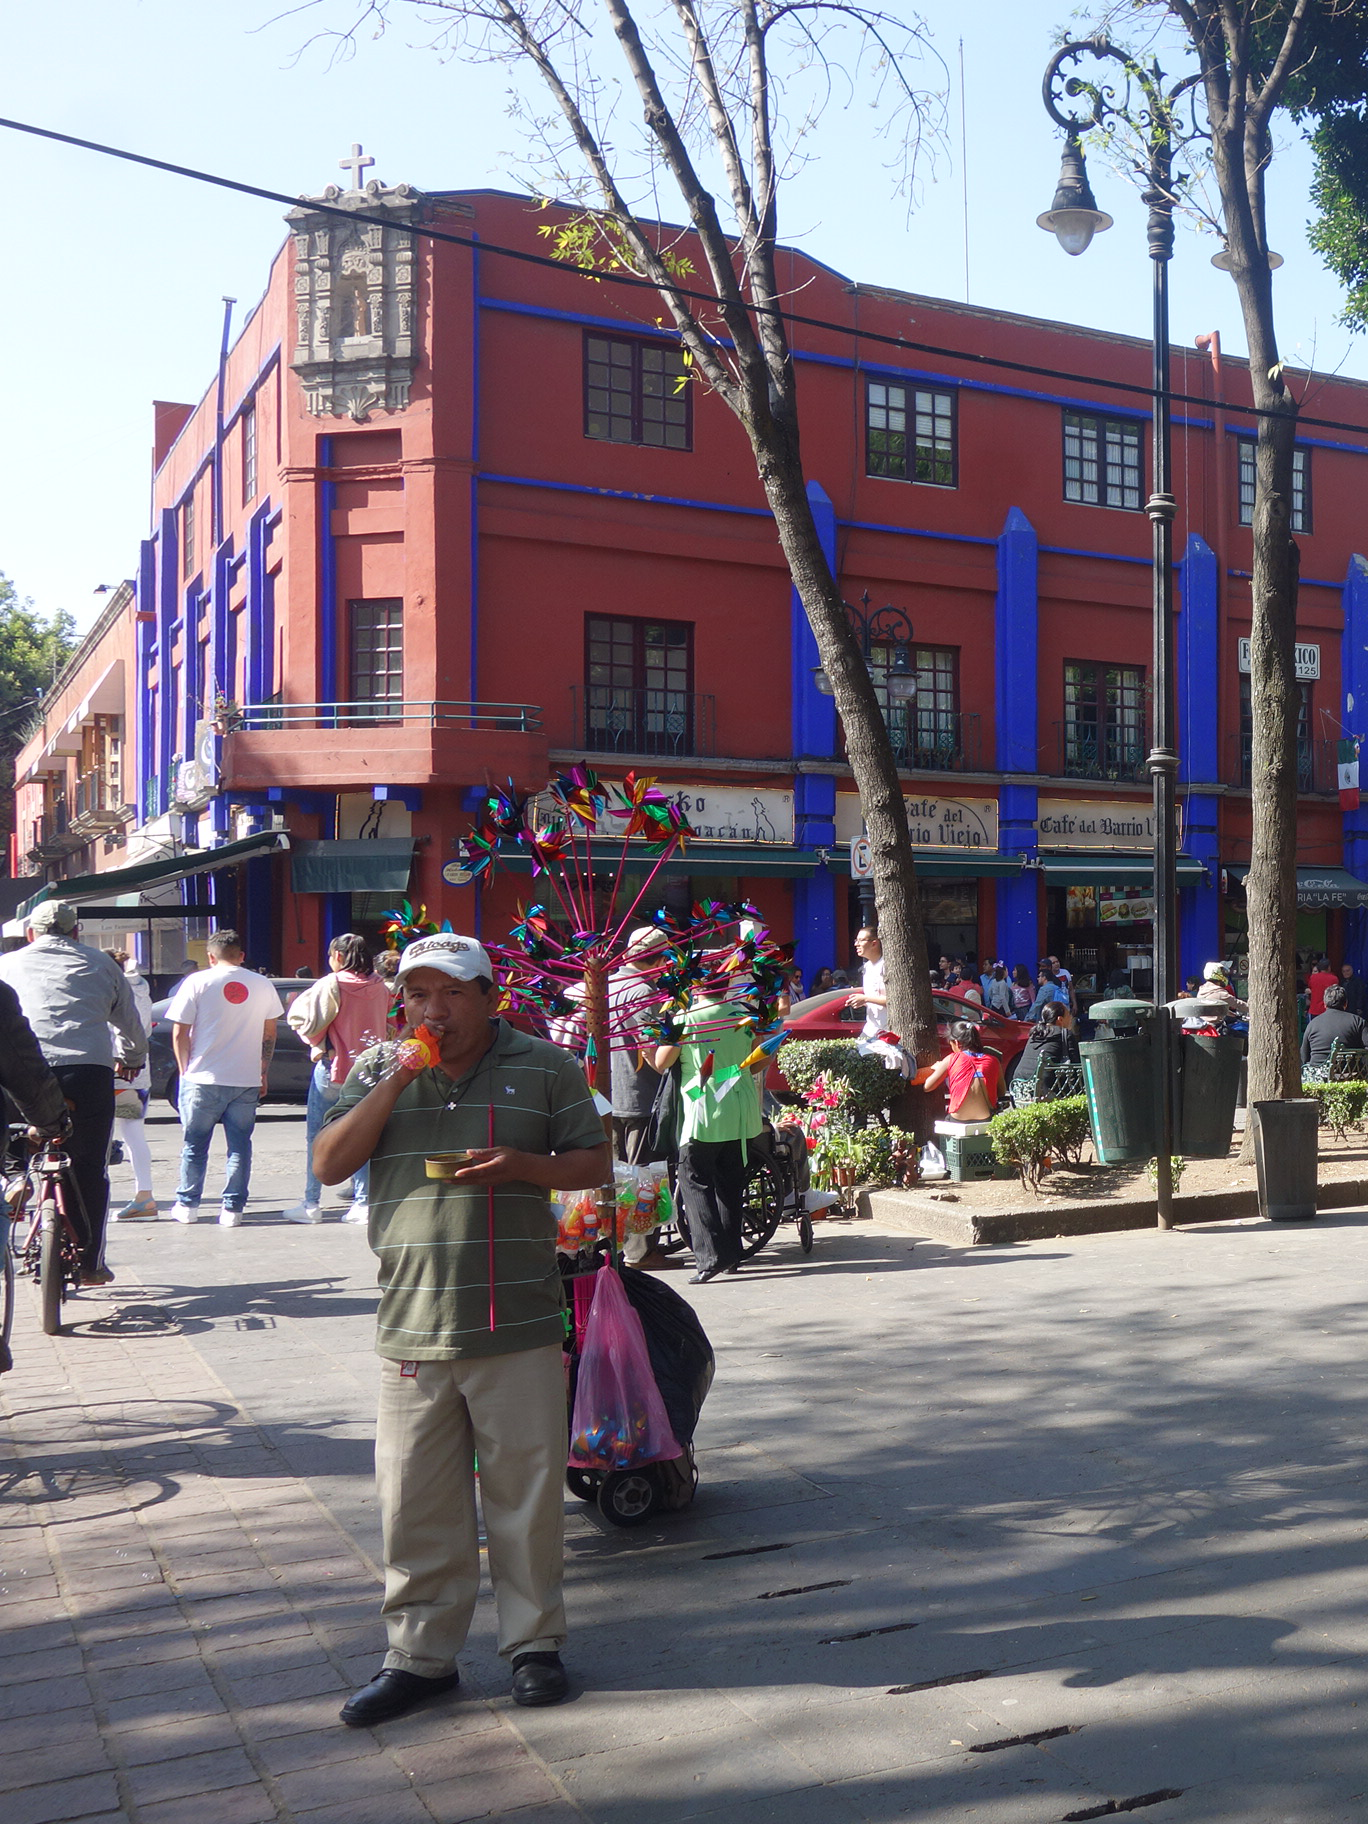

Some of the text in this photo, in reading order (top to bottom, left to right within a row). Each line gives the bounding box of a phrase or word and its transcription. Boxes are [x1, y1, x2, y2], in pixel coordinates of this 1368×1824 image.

[1298, 666, 1316, 675] 125
[944, 808, 963, 823] del
[1040, 814, 1077, 835] Café
[1079, 820, 1097, 834] del
[1099, 817, 1143, 837] Barrio
[938, 823, 981, 846] Viejo
[1297, 893, 1313, 902] RIA
